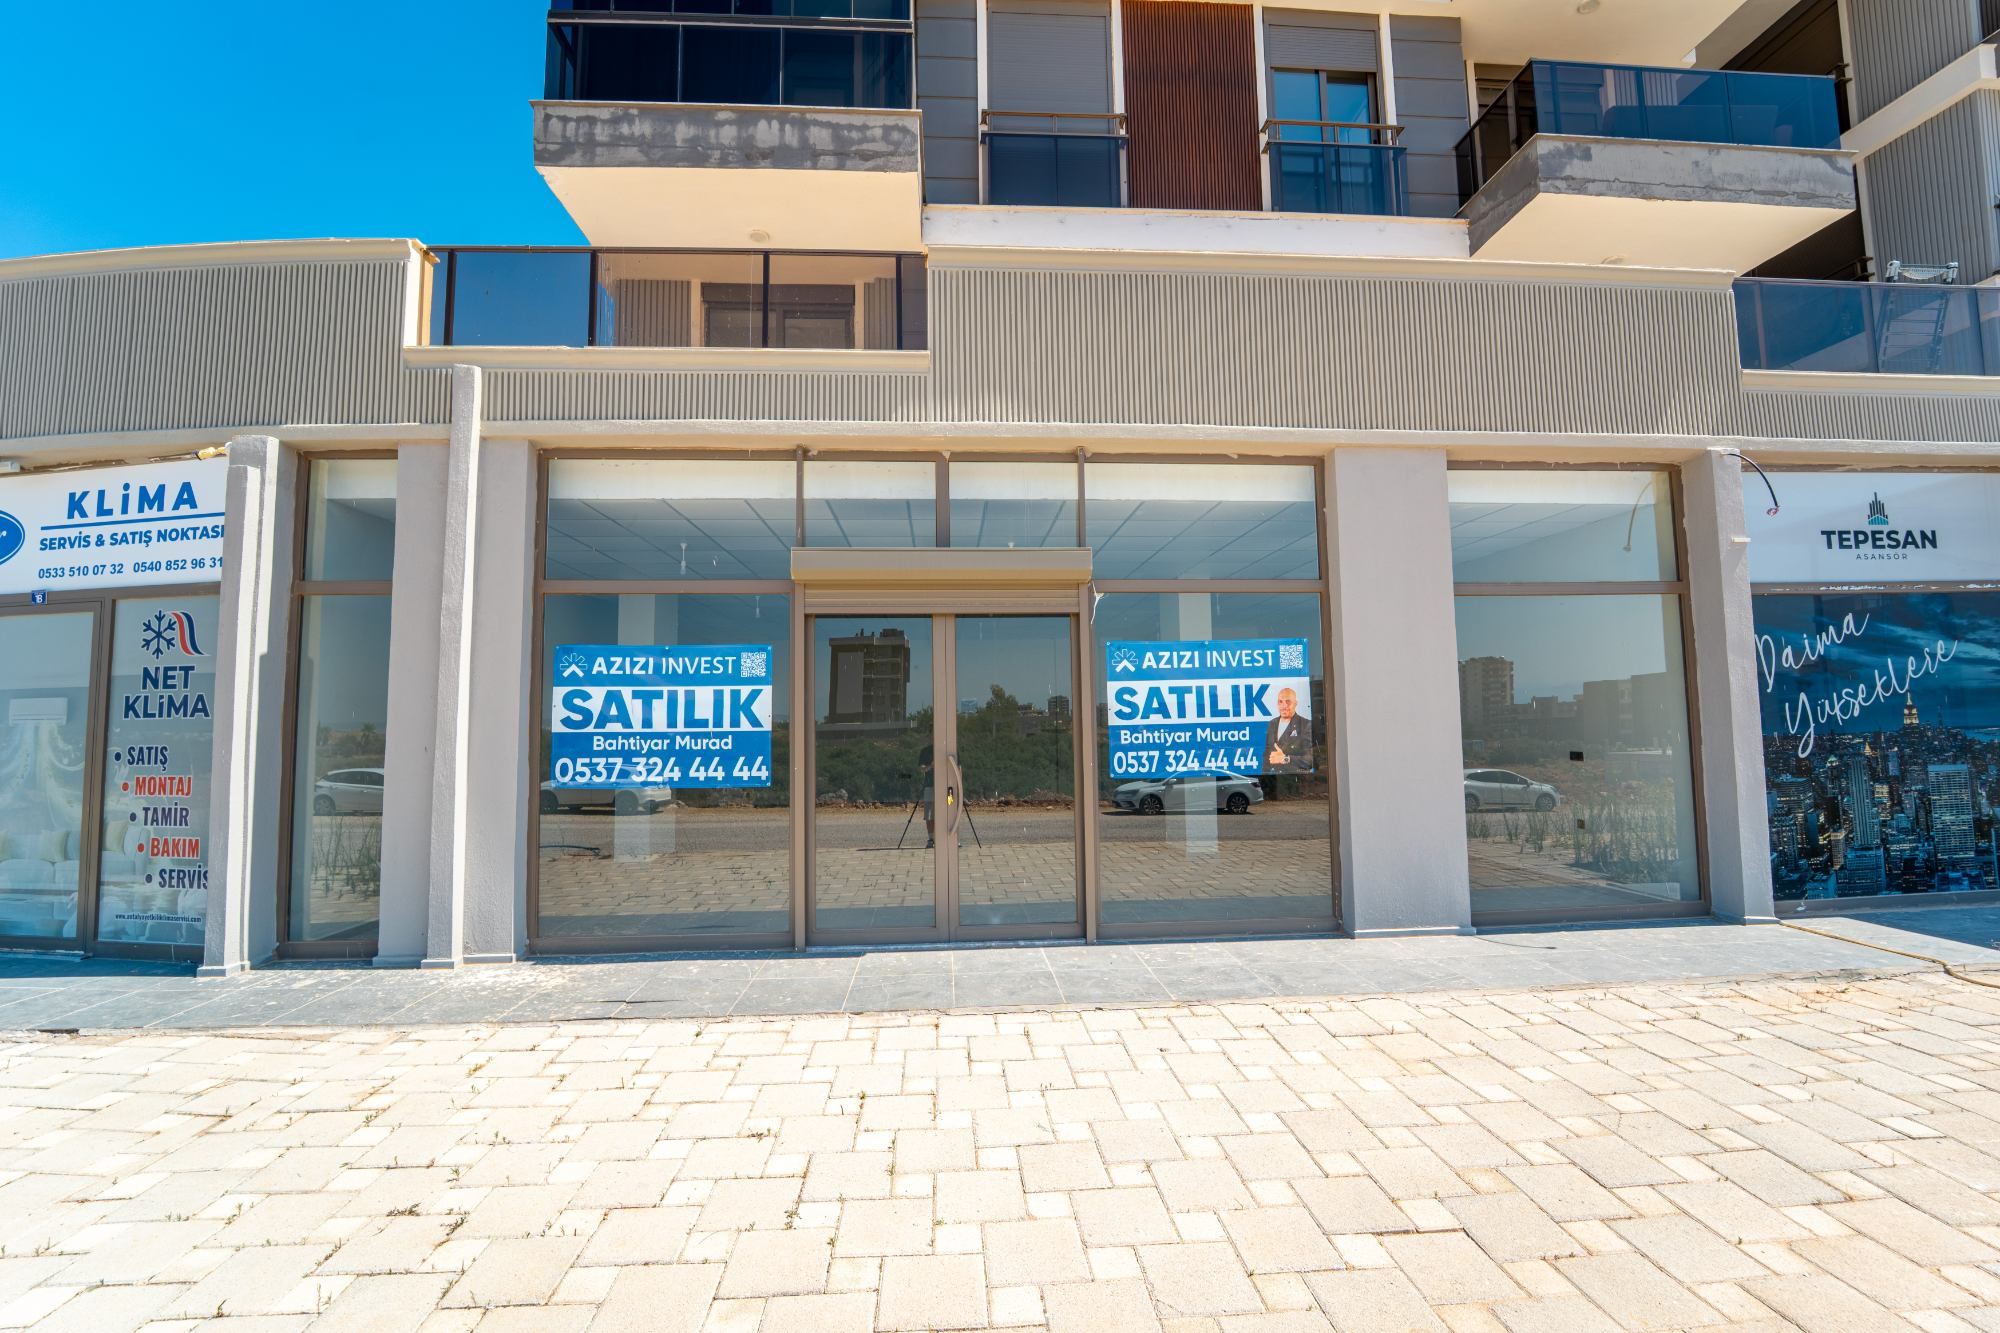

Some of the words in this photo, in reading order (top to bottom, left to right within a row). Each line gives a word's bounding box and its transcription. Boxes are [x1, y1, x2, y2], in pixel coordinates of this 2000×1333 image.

[39, 531, 91, 551] SERVİS
[95, 533, 106, 547] &
[110, 530, 152, 548] SATIŞ
[157, 524, 225, 543] NOKTASI
[1820, 530, 1938, 550] TEPESAN
[38, 566, 65, 579] 0533
[68, 565, 89, 577] 510
[92, 564, 106, 576] 07
[110, 563, 124, 575] 32
[133, 560, 161, 573] 0540
[165, 559, 187, 571] 852
[191, 557, 205, 570] 96
[209, 556, 223, 568] 31
[591, 656, 654, 675] AZIZI
[662, 656, 737, 675] INVEST
[1142, 651, 1200, 669] AZIZI
[1206, 649, 1276, 668] INVEST
[141, 665, 196, 690] NET
[559, 688, 764, 731] SATILIK
[1114, 683, 1273, 721] SATILIK
[593, 735, 670, 754] Bahtiyar
[675, 735, 732, 750] Murad
[1120, 728, 1192, 747] Bahtiyar
[1196, 727, 1250, 744] Murad
[127, 746, 168, 771] SATIŞ
[554, 757, 623, 783] 0537
[631, 756, 682, 782] 324
[688, 756, 725, 781] 44
[732, 756, 769, 781] 44
[1113, 750, 1160, 773] 0537
[1165, 749, 1199, 772] 324
[1204, 748, 1229, 770] 44
[1234, 747, 1259, 769] 44
[134, 776, 192, 796] MONTAJ
[142, 802, 190, 827] TAMİR
[150, 837, 200, 858] BAKIM
